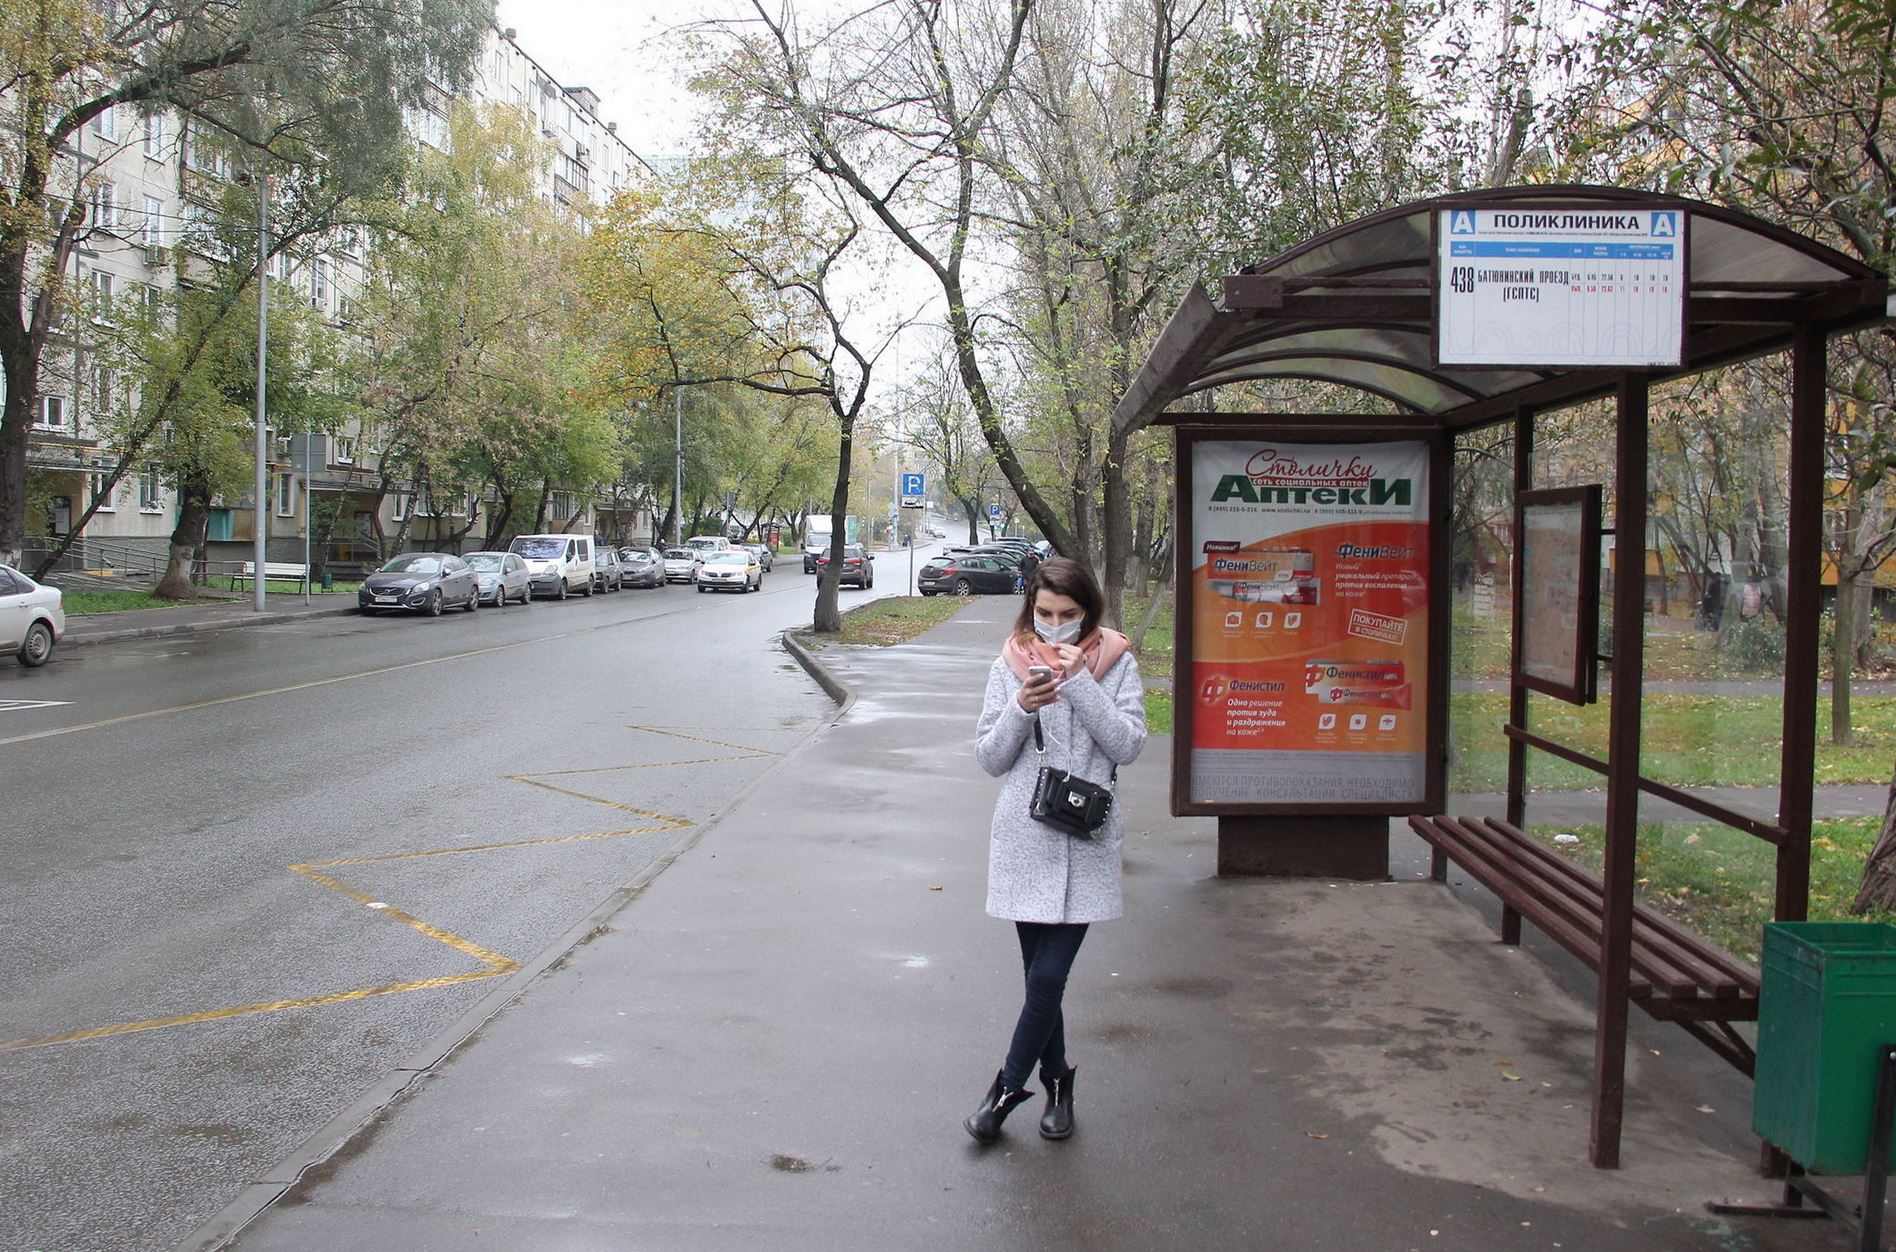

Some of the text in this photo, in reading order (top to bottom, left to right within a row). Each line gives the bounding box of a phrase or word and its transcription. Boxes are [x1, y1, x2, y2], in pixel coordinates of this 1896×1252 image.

[1494, 214, 1640, 229] ПОЛИКЛИНИКА
[1451, 266, 1474, 293] 438
[1477, 268, 1569, 285] БАТЮНИНСКИЙ ПРОЕЗД
[1245, 448, 1378, 477] Столички
[908, 475, 920, 494] P
[1252, 478, 1369, 488] сеть социальных аптек
[1338, 543, 1415, 559] ФениВейт
[1215, 558, 1278, 571] ФениВейт
[1335, 572, 1380, 580] уникальный
[1335, 582, 1364, 590] против
[1353, 613, 1404, 632] ПОКУПАЙТЕ
[1229, 679, 1285, 692] Фенистил
[1227, 697, 1283, 708] Одно решение
[1258, 708, 1277, 718] зуда
[1232, 718, 1286, 727] раздражения
[1240, 775, 1343, 787] ПРОТИВОПОКАЗАНИЯ
[1347, 776, 1414, 789] НЕОБХОДИМО
[1191, 786, 1414, 800] ПОЛУЧЕНИЕ КОНСУЛЬТАЦИИ СПЕЦИАЛИСТА
